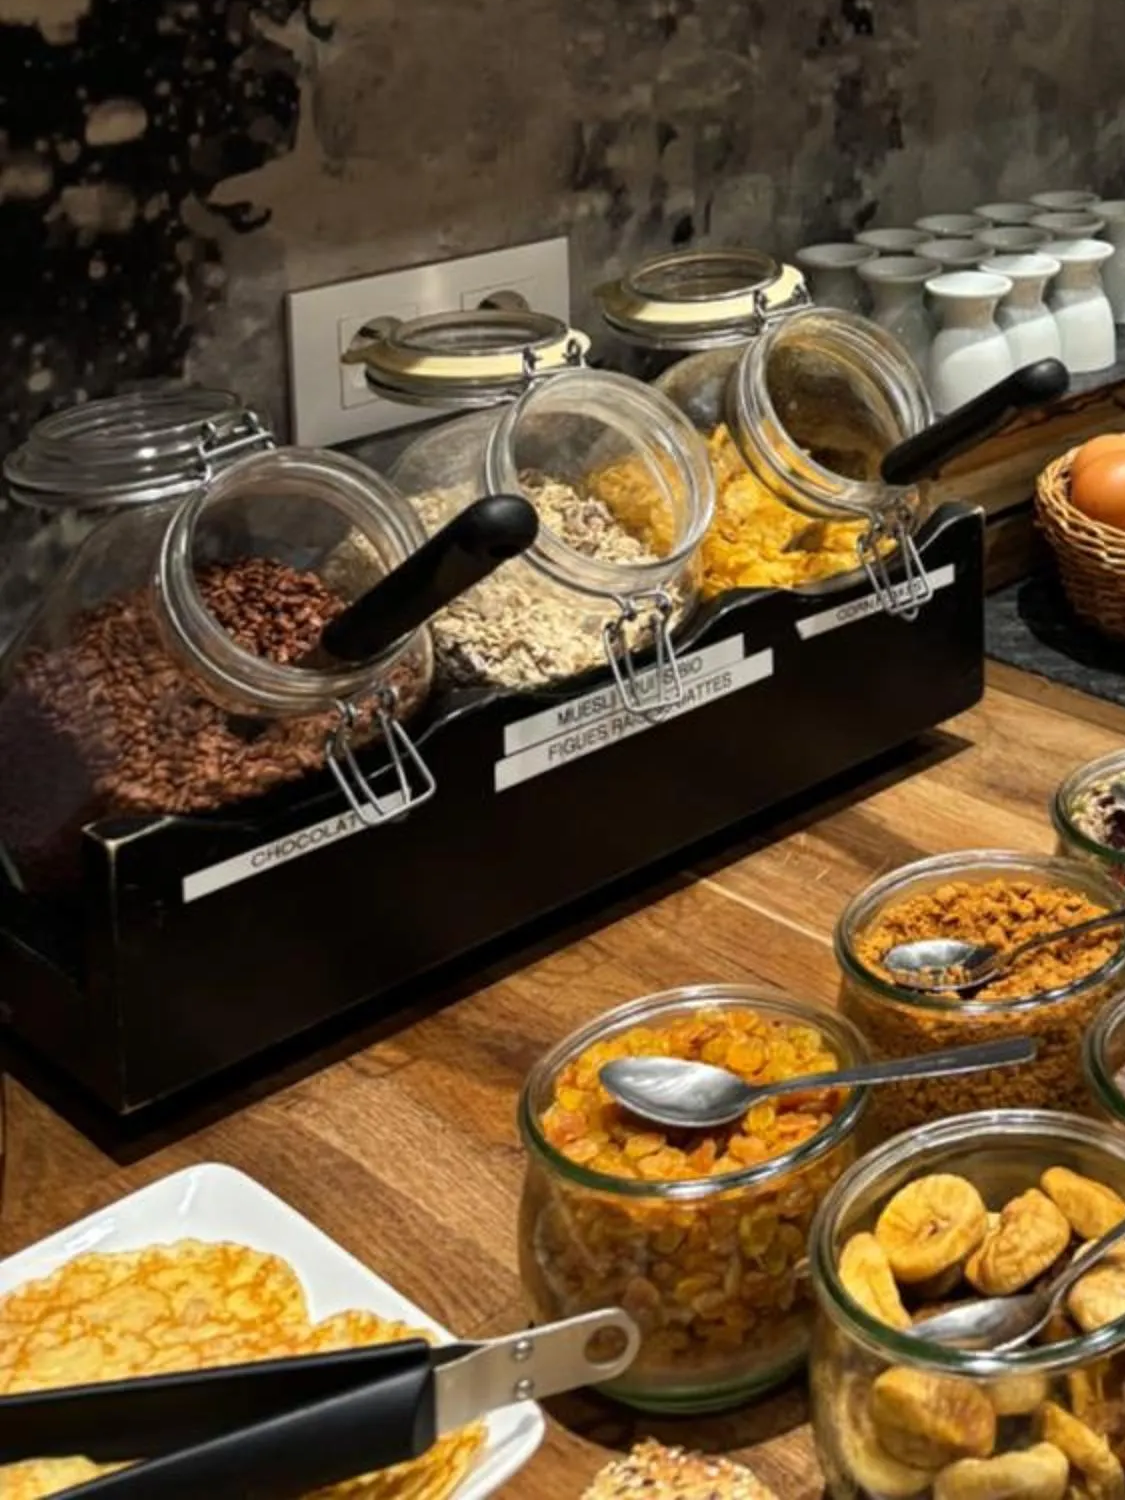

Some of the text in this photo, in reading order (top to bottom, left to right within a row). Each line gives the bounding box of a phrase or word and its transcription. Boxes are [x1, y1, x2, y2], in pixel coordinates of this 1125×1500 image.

[557, 691, 617, 726] MUESLI
[548, 722, 609, 760] FIGUES
[251, 814, 357, 868] CHOCOLAT
